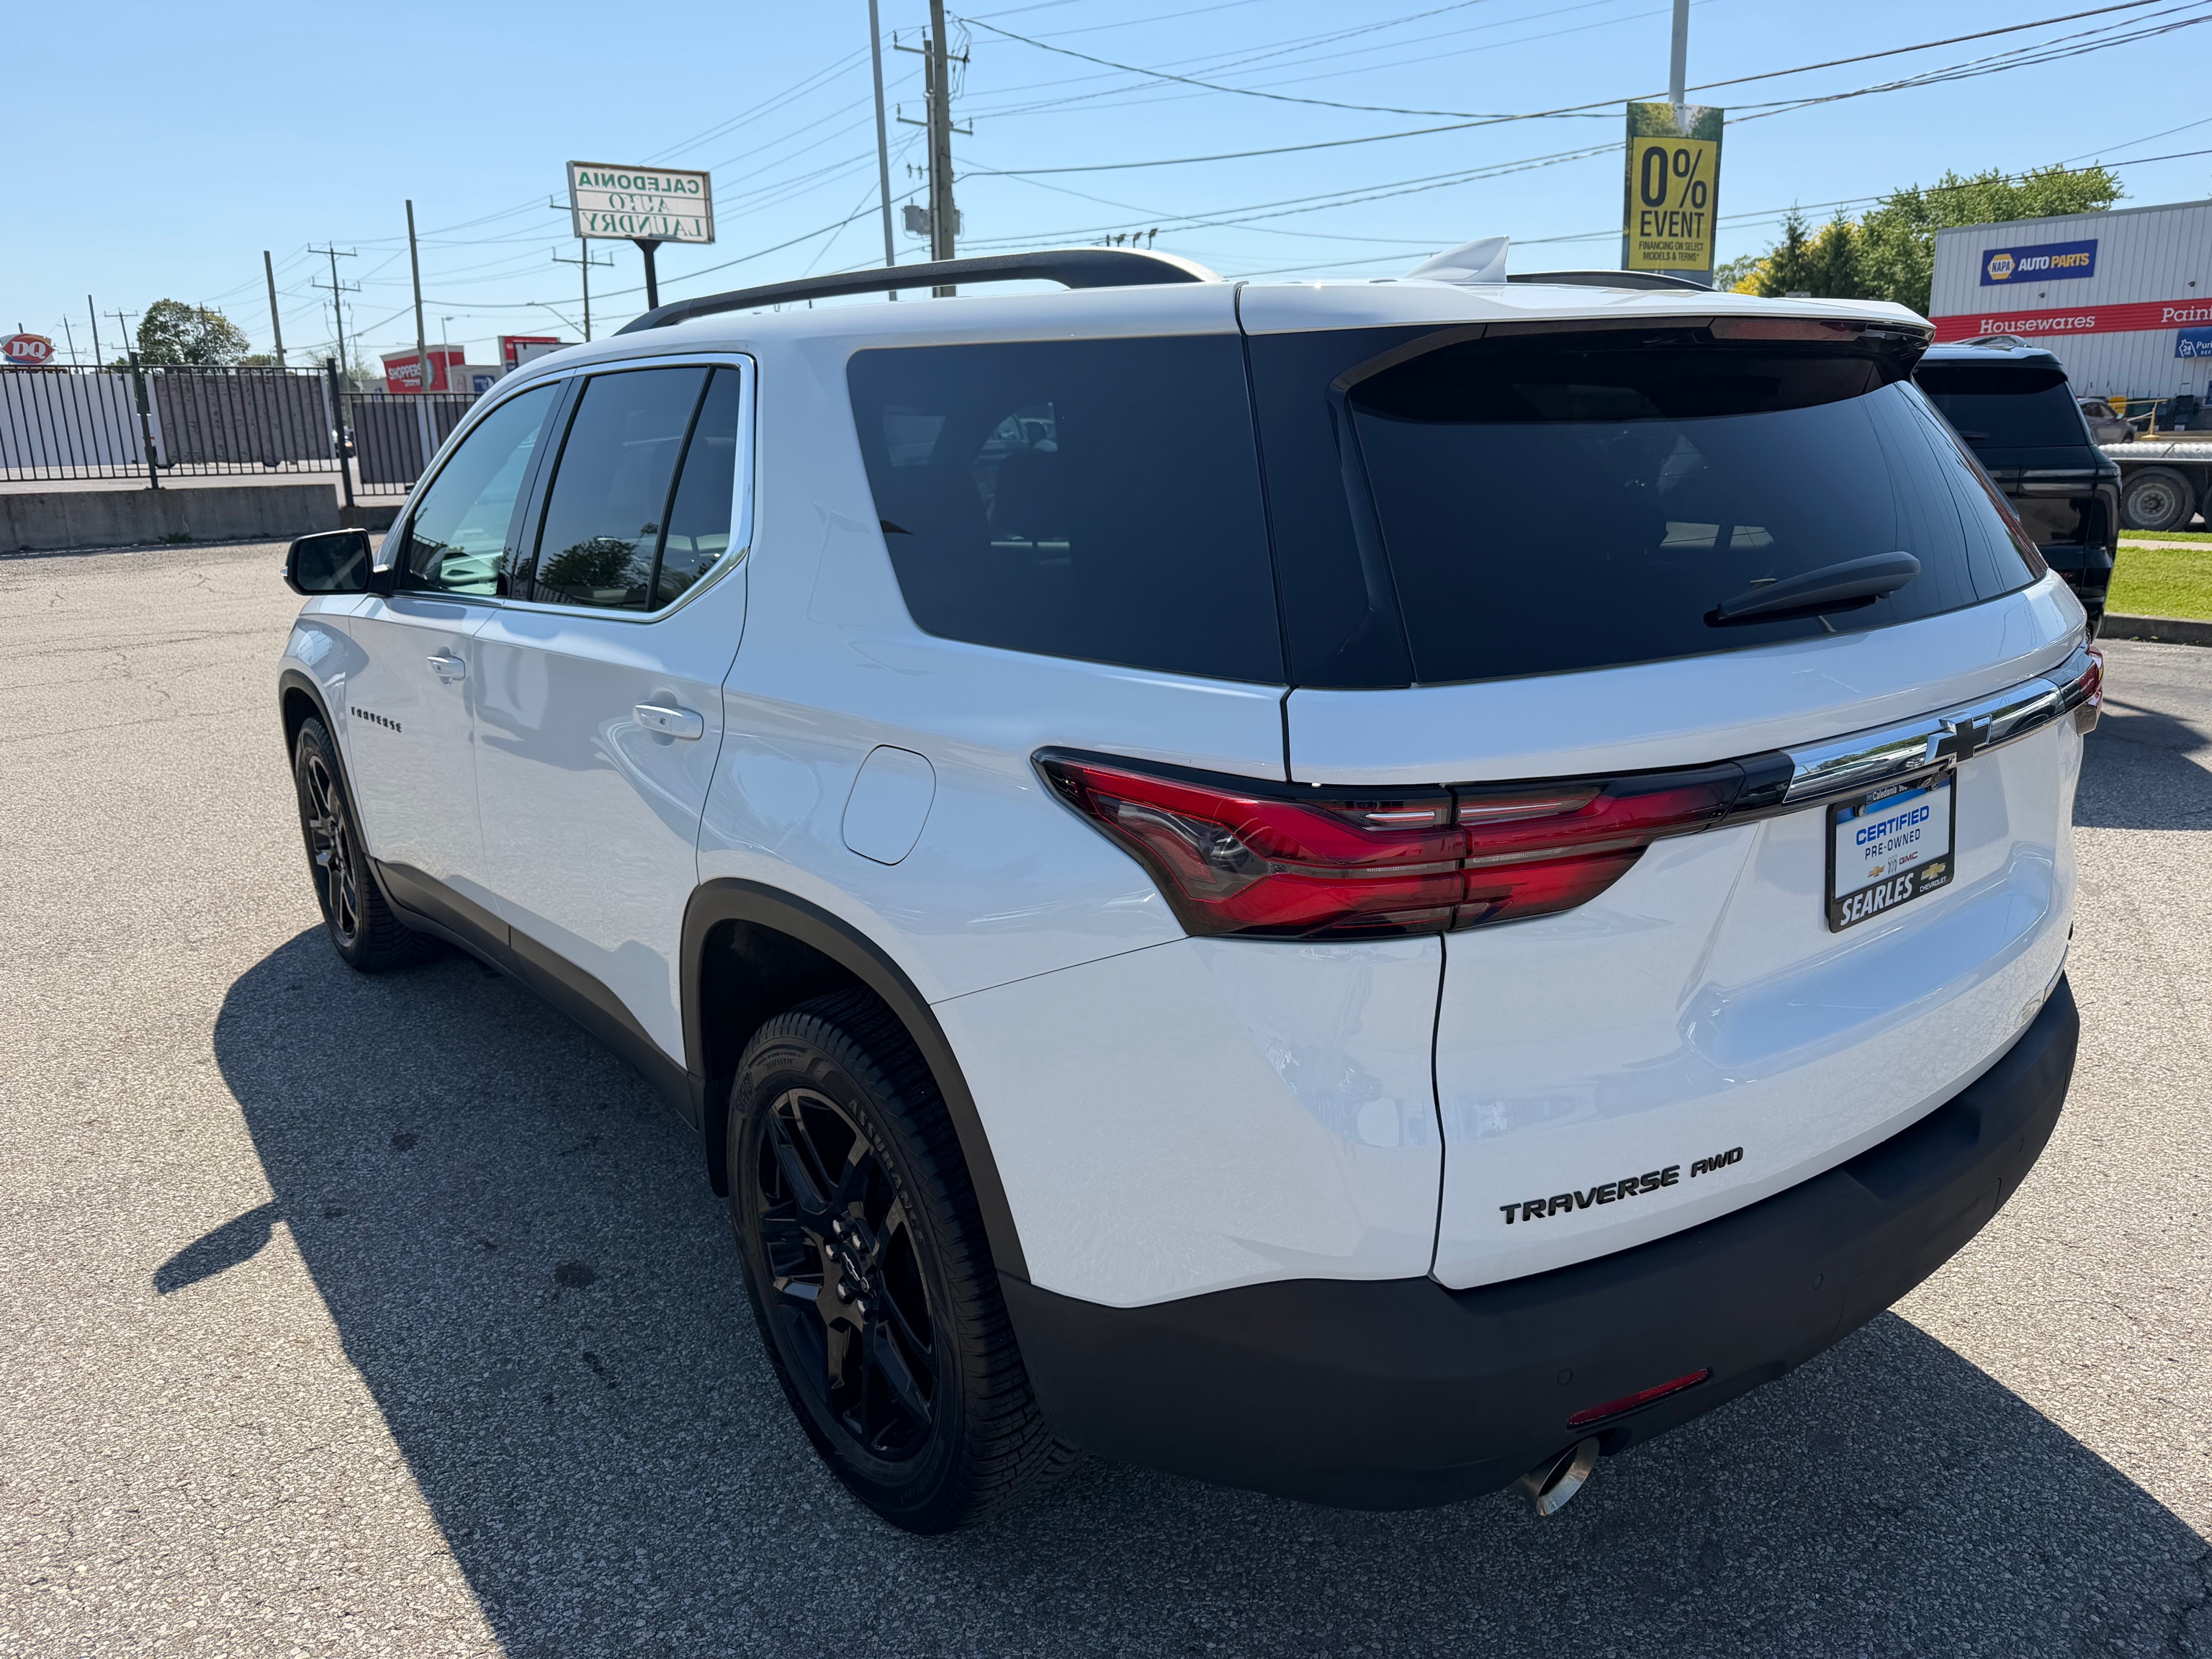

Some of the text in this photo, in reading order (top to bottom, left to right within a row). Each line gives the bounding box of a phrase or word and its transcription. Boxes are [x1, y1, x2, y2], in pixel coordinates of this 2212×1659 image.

[1641, 146, 1707, 209] 0%
[1640, 210, 1705, 239] EVENT
[1638, 240, 1704, 251] FINANCING ON SELECT
[1642, 251, 1671, 261] MODELS
[1671, 252, 1677, 261] &
[1992, 253, 2090, 273] NAPA AUTO PARTS
[1979, 315, 2095, 334] Housewares
[12, 341, 46, 359] DQ
[1873, 785, 1897, 801] Caledonia
[1856, 805, 1930, 845] CERTIFIED
[1865, 828, 1920, 860] PRE-OWNED
[1899, 851, 1918, 865] GMC
[1920, 876, 1947, 893] CHEVROLET
[1840, 872, 1915, 926] SEARLES
[1500, 1146, 1744, 1225] TRAVERSE AWD
